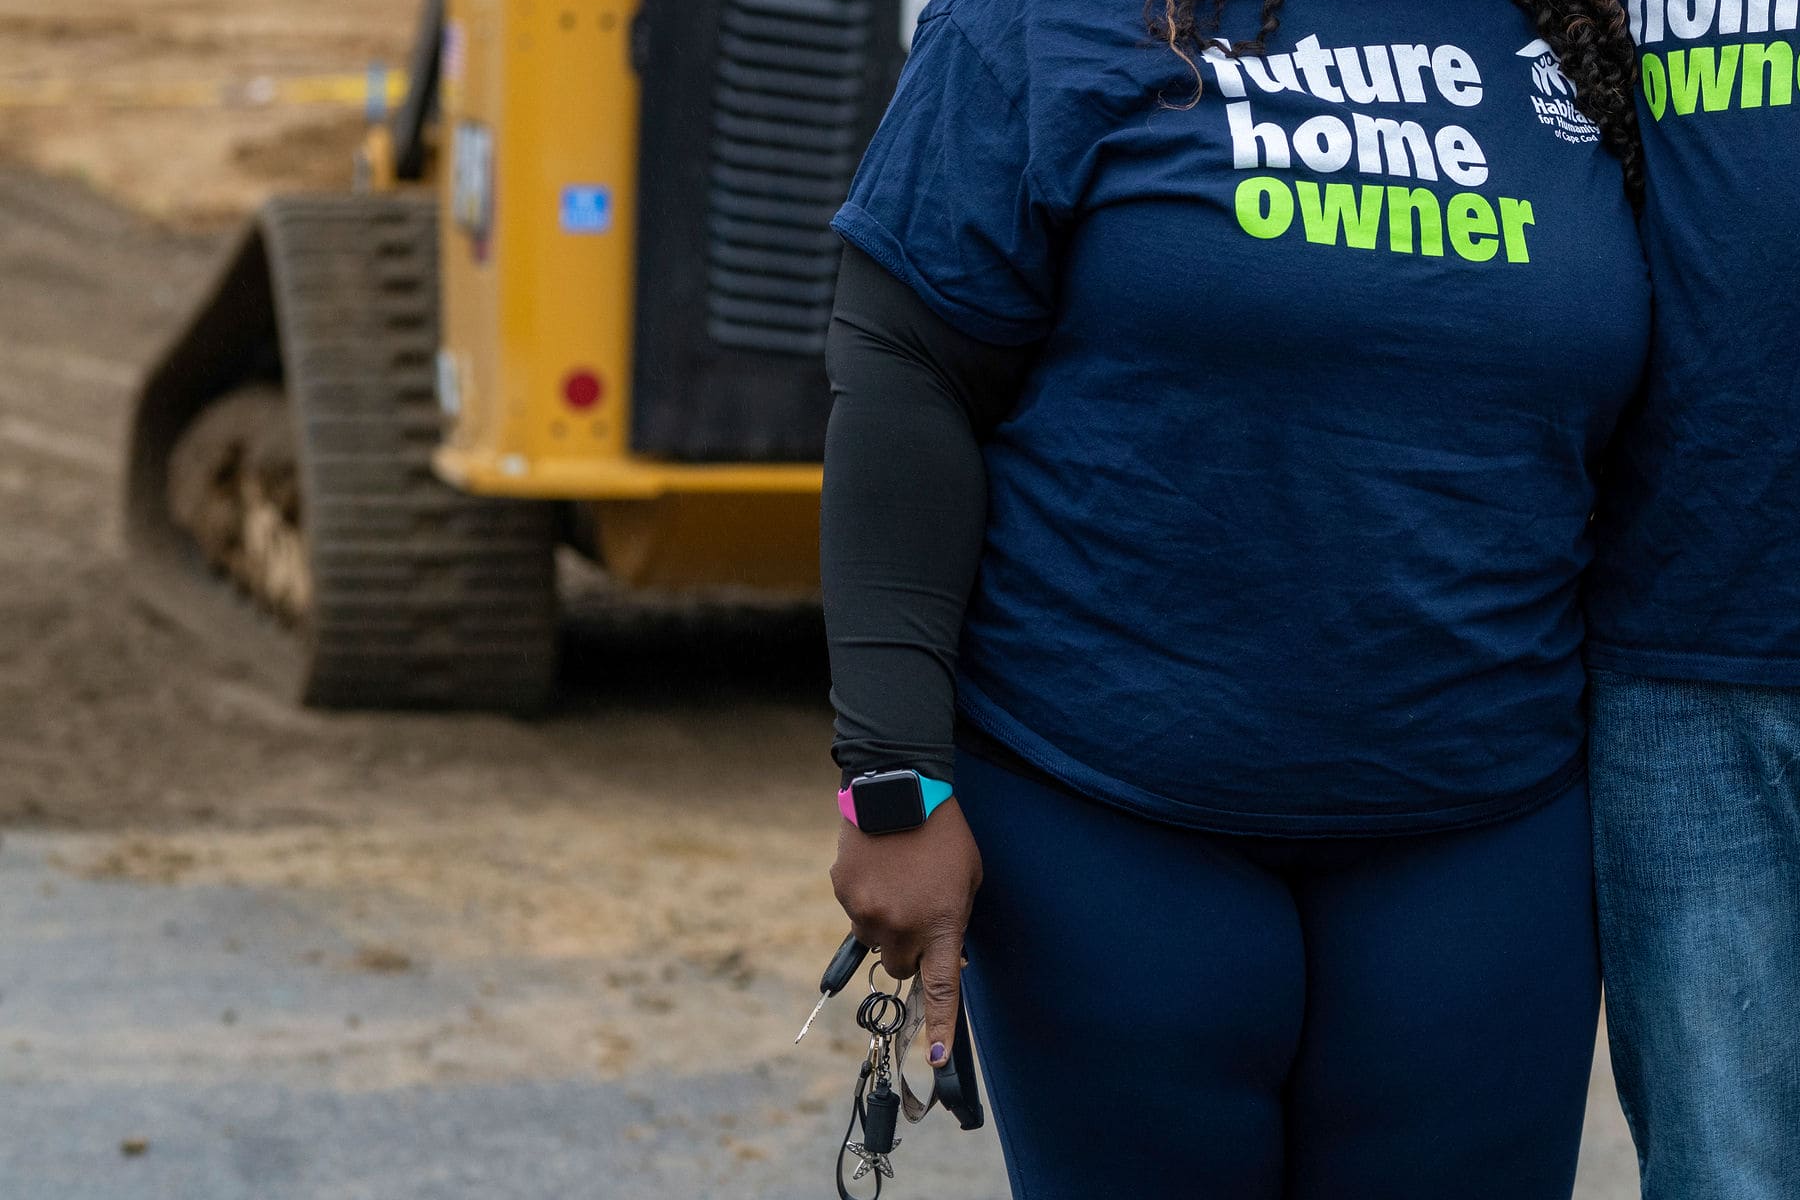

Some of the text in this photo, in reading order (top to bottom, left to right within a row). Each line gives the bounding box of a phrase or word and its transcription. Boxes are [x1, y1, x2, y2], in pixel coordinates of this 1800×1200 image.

[1201, 33, 1484, 107] future
[1226, 100, 1489, 186] home
[1538, 114, 1555, 126] for
[1554, 129, 1562, 139] of
[1562, 131, 1581, 145] Cape
[1234, 176, 1536, 263] owner
